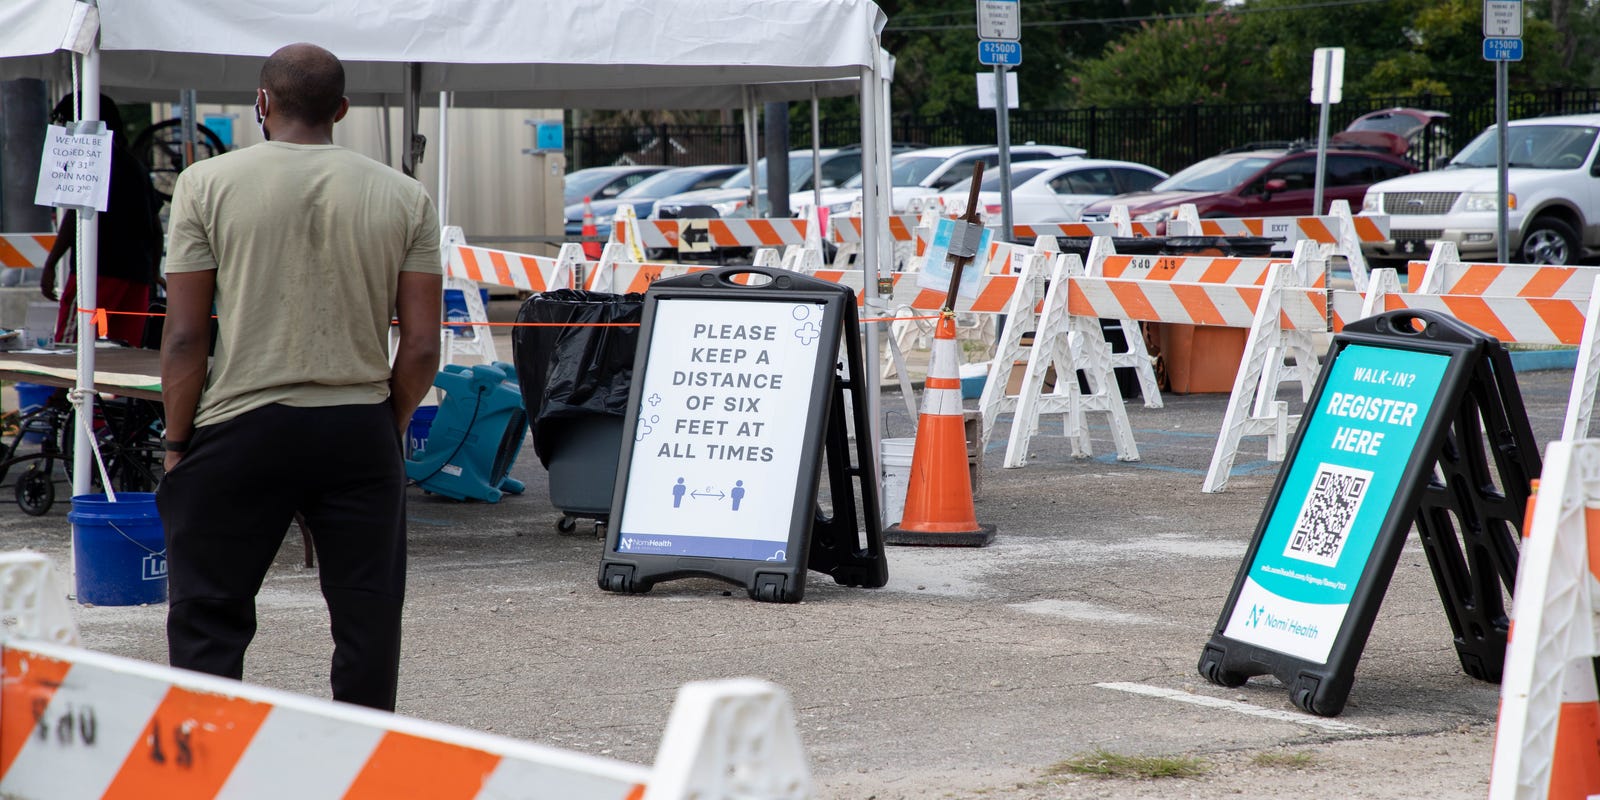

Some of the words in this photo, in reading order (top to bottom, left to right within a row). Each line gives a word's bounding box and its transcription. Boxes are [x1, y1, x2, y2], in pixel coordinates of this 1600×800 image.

[991, 53, 1009, 63] FINE
[1495, 50, 1511, 58] FINE
[55, 136, 70, 144] WE
[92, 138, 102, 146] BE
[86, 150, 102, 158] SAT
[76, 174, 99, 183] MON
[56, 184, 74, 192] AUG
[1271, 224, 1289, 232] EXIT
[693, 324, 777, 341] PLEASE
[691, 347, 747, 364] KEEP
[755, 349, 770, 365] A
[672, 371, 783, 390] DISTANCE
[1353, 366, 1416, 388] WALK-IN?
[686, 395, 715, 411] OF
[723, 396, 761, 413] SIX
[1326, 391, 1418, 427] REGISTER
[675, 419, 729, 436] FEET
[736, 421, 765, 437] AT
[1331, 426, 1385, 456] HERE
[657, 442, 696, 459] ALL
[706, 444, 774, 462] TIMES
[1264, 613, 1290, 631] Nomi
[1288, 620, 1319, 639] Health
